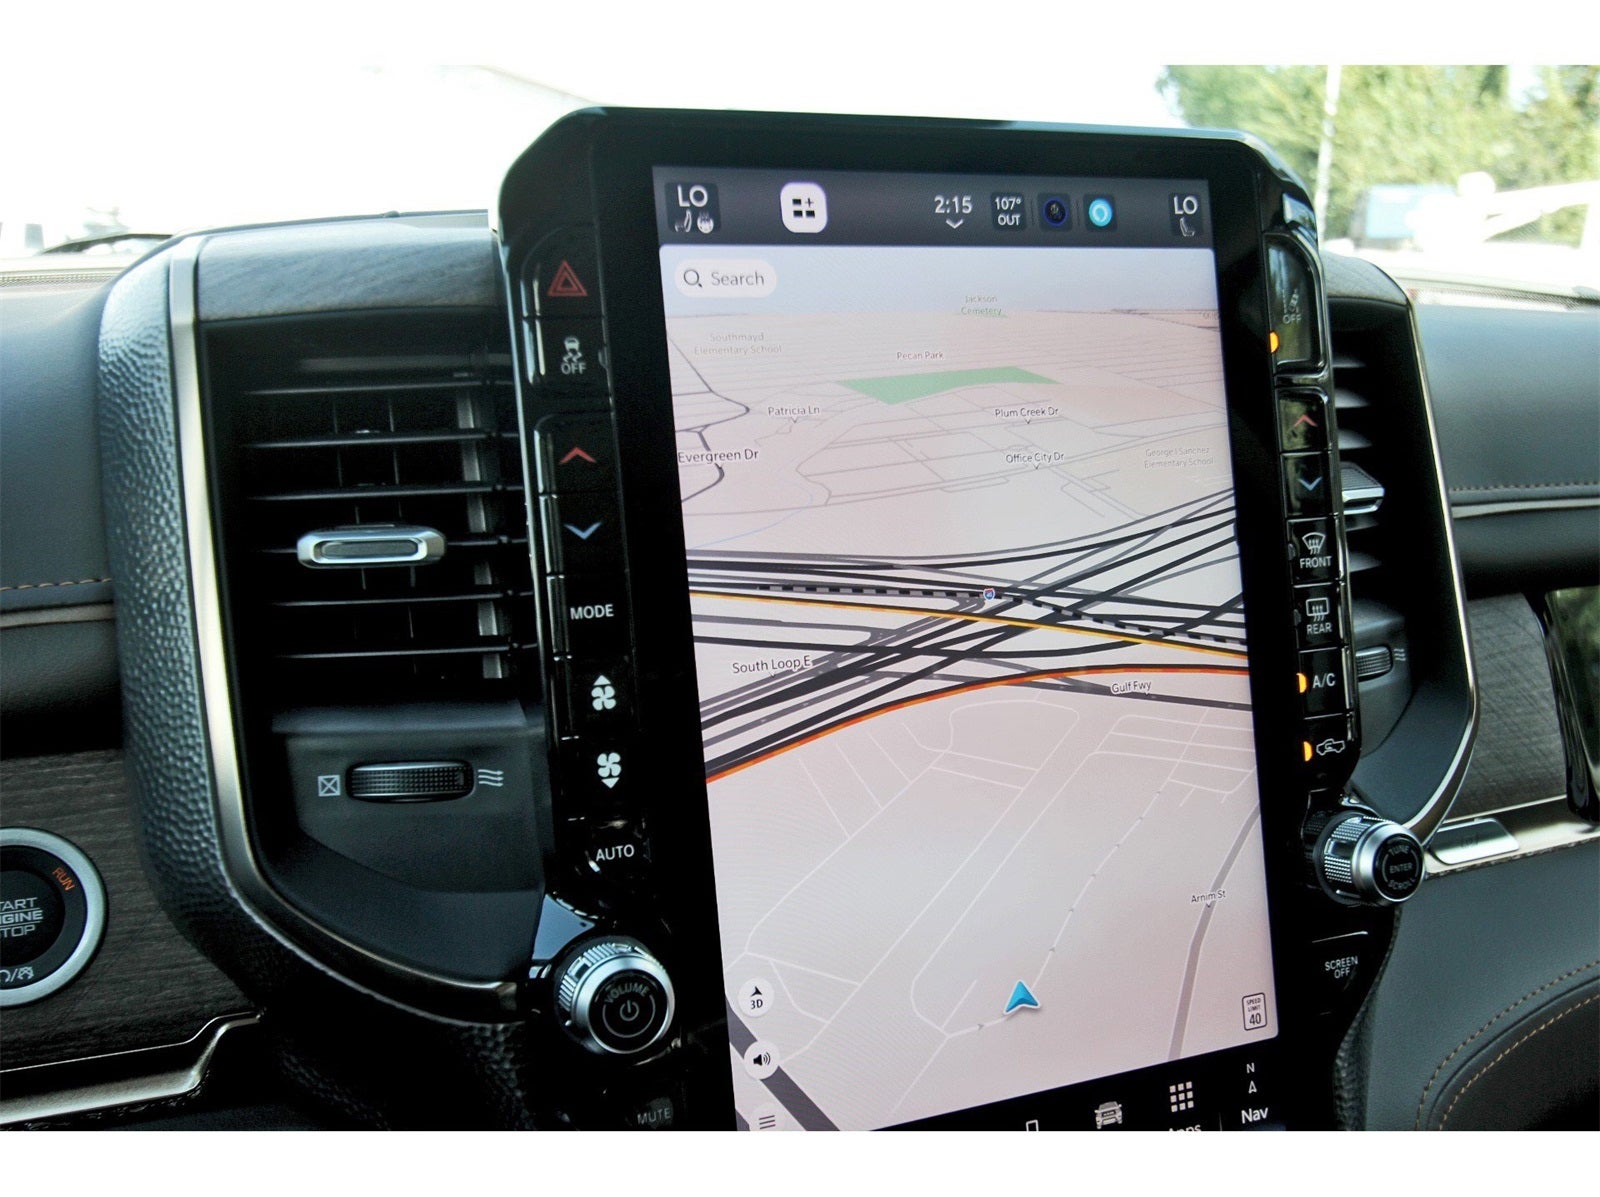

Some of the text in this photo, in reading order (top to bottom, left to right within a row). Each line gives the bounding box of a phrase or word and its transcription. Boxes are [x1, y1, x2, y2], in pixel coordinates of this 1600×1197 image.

[677, 184, 709, 208] LO
[934, 195, 972, 214] 2:15
[1173, 195, 1199, 215] LO
[997, 214, 1021, 226] OUT
[711, 270, 765, 286] Search
[961, 306, 1002, 316] Cemetery
[1282, 313, 1302, 324] OFF
[694, 344, 782, 355] Elementary School
[896, 350, 944, 360] Pecan Park
[560, 362, 587, 375] OFF
[768, 405, 820, 416] Patricia Ln
[995, 406, 1059, 418] Plum Creek Dr
[678, 449, 759, 464] Evergreen Dr
[1005, 452, 1065, 464] Office City Dr
[1300, 555, 1332, 568] FRONT
[570, 604, 614, 620] MODE
[1306, 623, 1333, 635] REAR
[732, 655, 811, 674] South Loop E
[1112, 680, 1151, 693] Gulf Fwy
[1312, 673, 1336, 689] A/C
[596, 844, 635, 862] AUTO
[1389, 862, 1414, 875] ENTER
[52, 867, 76, 891] RUN
[1191, 889, 1226, 903] Arnim St
[0, 910, 43, 925] GINE
[0, 924, 36, 938] TOP
[1324, 956, 1358, 971] SCREEN
[1334, 968, 1351, 979] OFF
[604, 981, 650, 1004] VOLUME
[750, 998, 763, 1010] 3D
[1249, 1012, 1262, 1026] 40
[1246, 1062, 1255, 1074] N
[637, 1107, 672, 1125] MUTE
[1241, 1107, 1269, 1125] Nav
